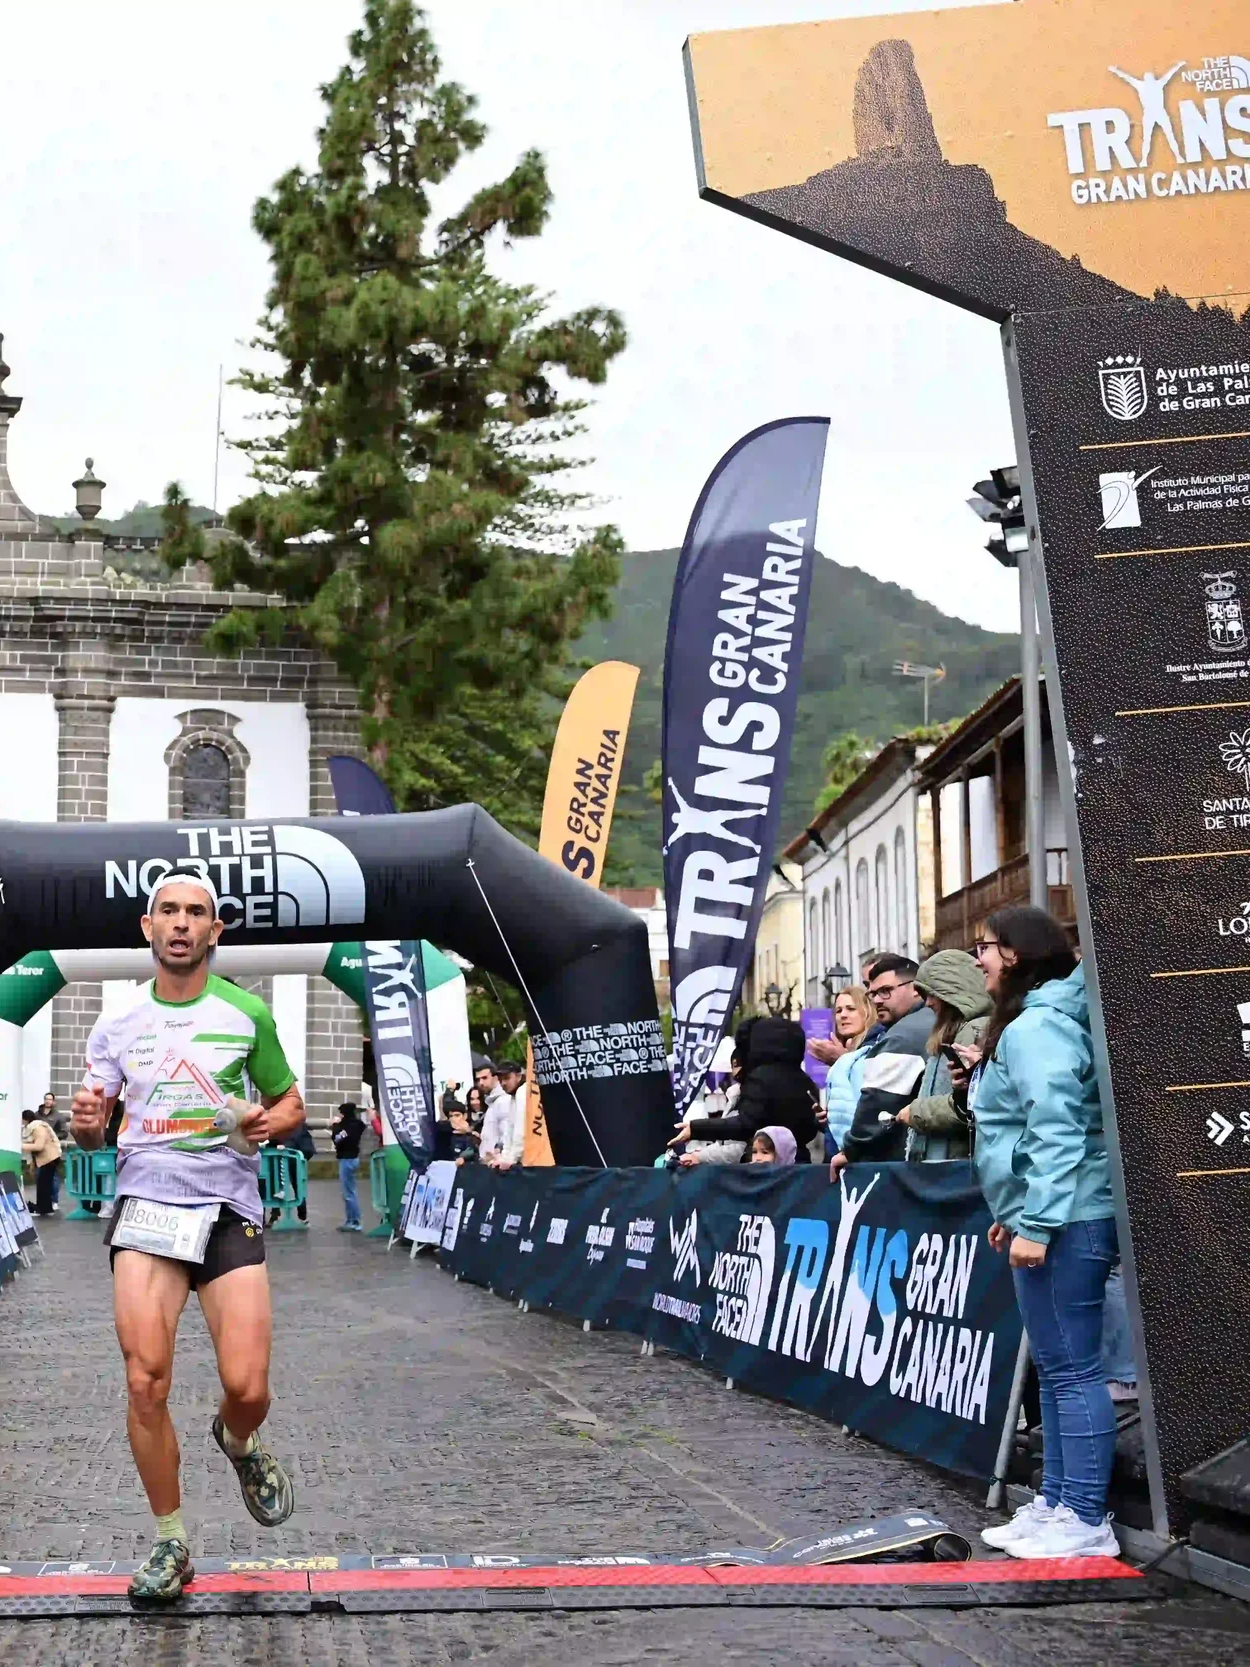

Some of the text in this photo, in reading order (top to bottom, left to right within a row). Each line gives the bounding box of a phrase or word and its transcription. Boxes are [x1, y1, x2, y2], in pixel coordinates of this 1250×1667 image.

[1202, 56, 1229, 69] THE
[1182, 68, 1231, 84] NORTH
[1196, 79, 1232, 92] FACE
[1071, 173, 1147, 204] GRAN
[1157, 382, 1178, 396] de
[1187, 380, 1215, 394] Las
[1159, 398, 1180, 412] de
[1183, 395, 1221, 410] Gran
[1151, 478, 1189, 488] Instituto
[1190, 473, 1236, 487] Municipal
[1154, 490, 1166, 499] de
[1168, 488, 1178, 498] la
[1178, 486, 1222, 498] Actividad
[1167, 502, 1184, 512] Las
[1187, 499, 1223, 511] Palmas
[1225, 497, 1240, 507] de
[747, 517, 808, 695] CANARIA
[708, 572, 760, 689] GRAN
[566, 757, 595, 835] GRAN
[583, 729, 621, 844] CANARIA
[1204, 816, 1227, 830] DE
[177, 825, 272, 856] THE
[219, 894, 274, 929] CE
[340, 956, 363, 969] Agu
[573, 1025, 603, 1040] THE
[599, 1034, 648, 1051] NORTH
[534, 1059, 556, 1073] ORTH
[577, 1050, 617, 1067] FACE
[546, 1060, 649, 1085] NORTH FACE
[736, 1213, 764, 1253] THE
[708, 1250, 751, 1293] NORTH
[905, 1232, 979, 1320] GRAN
[889, 1316, 996, 1426] CANARIA
